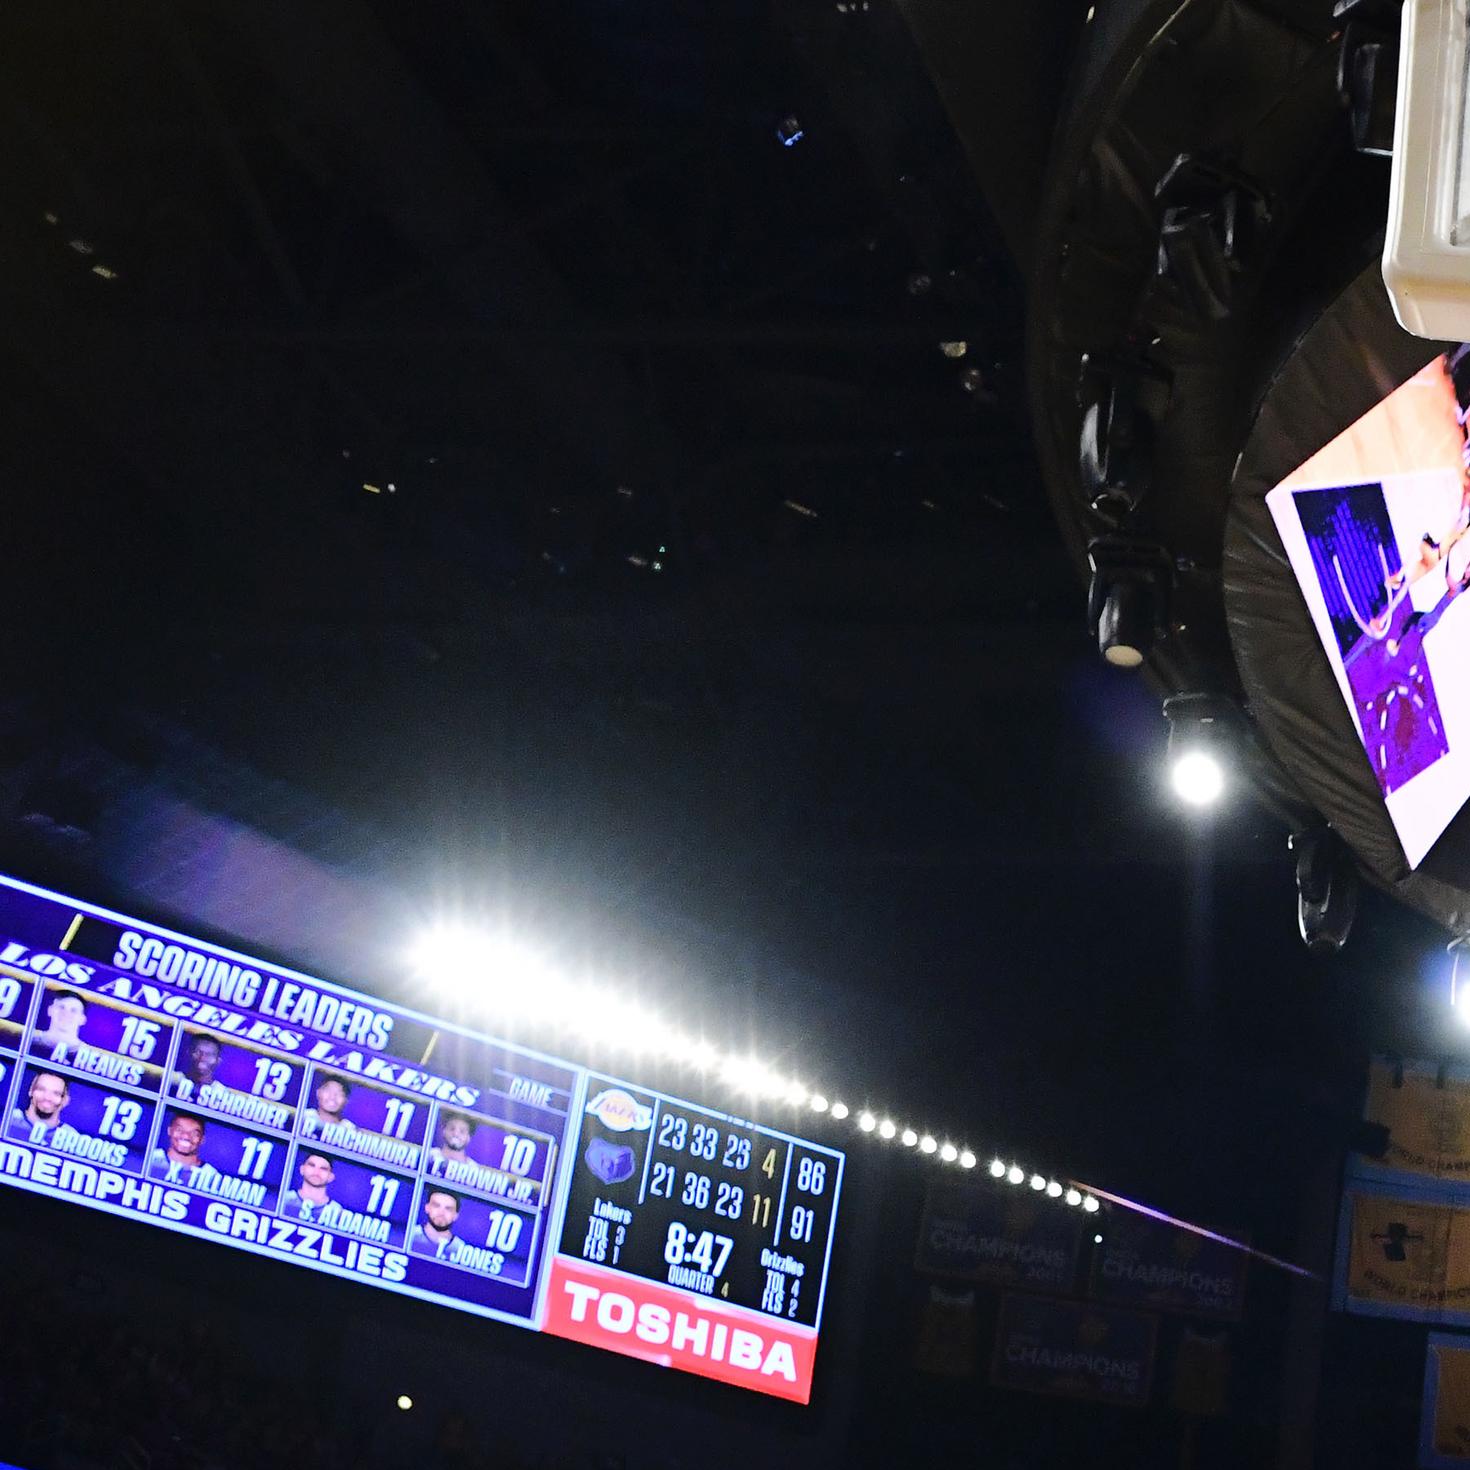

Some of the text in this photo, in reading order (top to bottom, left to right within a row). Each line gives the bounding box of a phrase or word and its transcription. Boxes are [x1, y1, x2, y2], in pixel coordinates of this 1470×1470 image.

[113, 930, 395, 1051] SCORING LEADERS
[0, 941, 481, 1108] LOS ANGELES LAKERS
[117, 1015, 162, 1061] 15
[51, 1041, 146, 1087] A. REAVES
[99, 1095, 143, 1142] 13
[29, 1120, 129, 1168] D. BROOKS
[238, 1136, 274, 1181] 11
[165, 1160, 268, 1208] X. TILLMAN
[797, 1156, 827, 1196] 86
[0, 1144, 410, 1283] MEMPHIS GRIZZLIES
[789, 1204, 816, 1244] 91
[664, 1221, 736, 1279] 8:47
[564, 1279, 798, 1383] TOSHIBA
